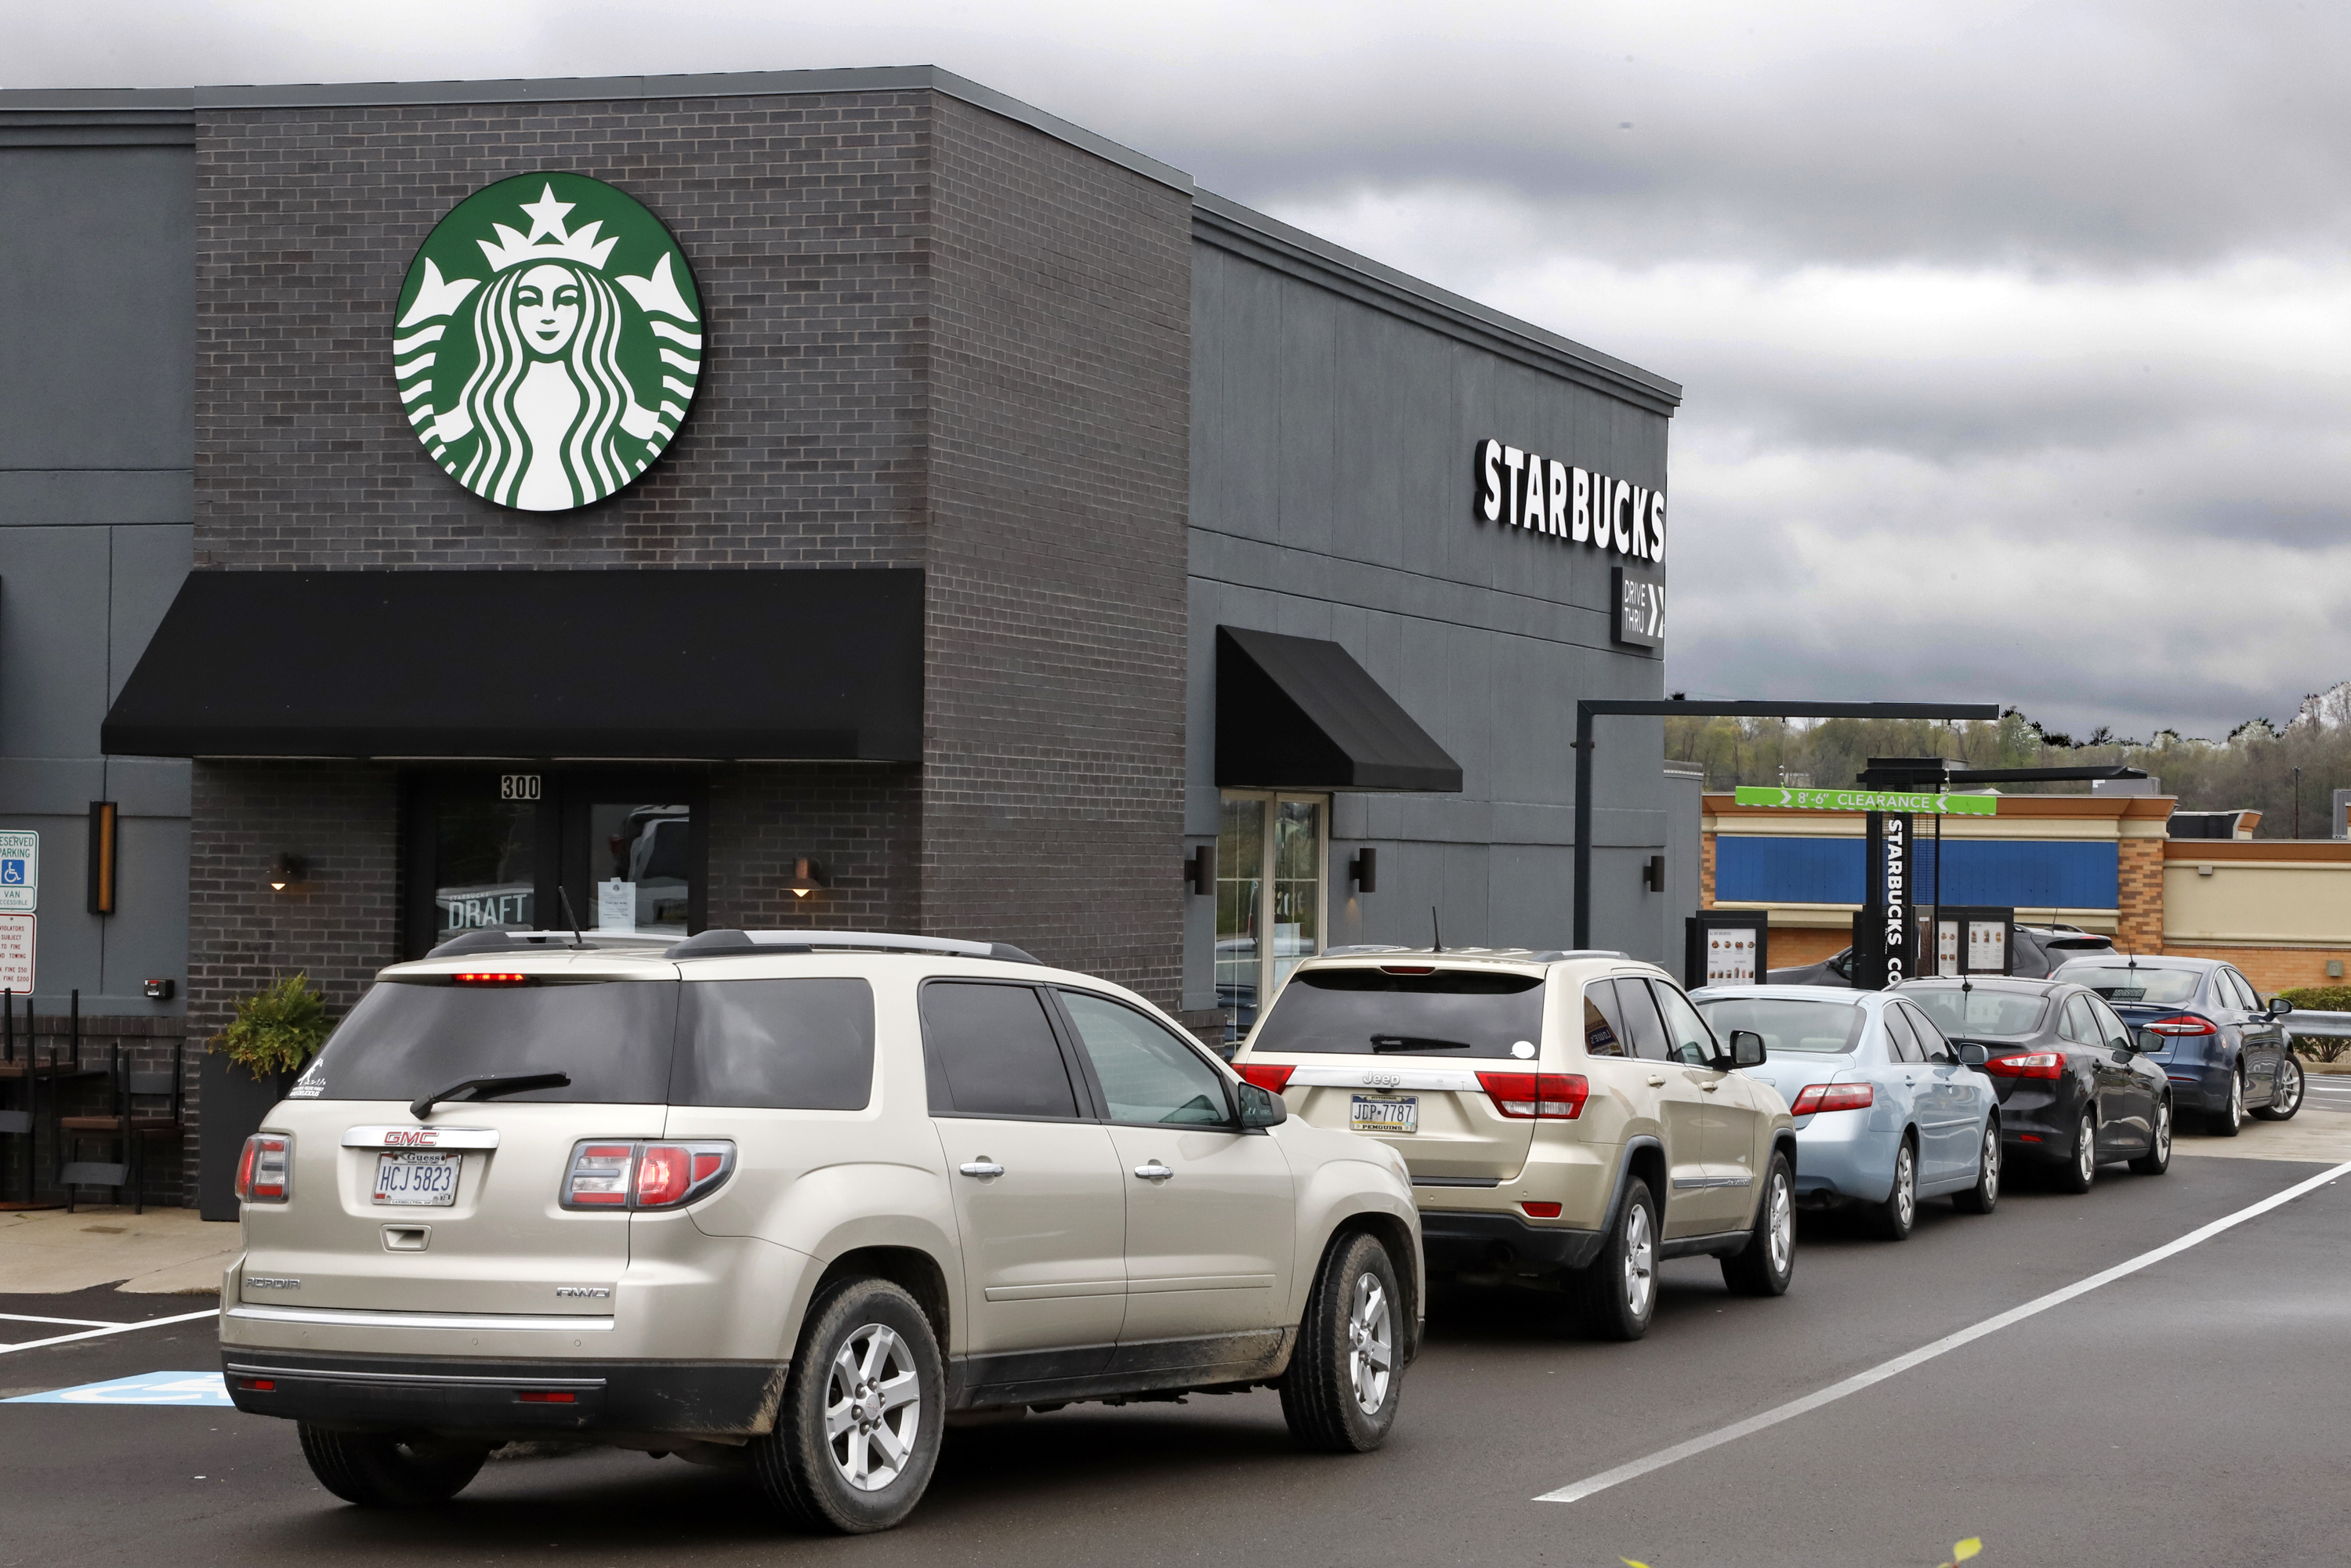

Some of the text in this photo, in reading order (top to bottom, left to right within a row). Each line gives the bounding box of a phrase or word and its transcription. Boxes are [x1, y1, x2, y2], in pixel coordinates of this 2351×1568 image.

[1483, 438, 1665, 563] STARBUCKS
[1625, 579, 1646, 607] DRIVE
[1625, 607, 1644, 634] THRU
[502, 776, 539, 798] 300
[1837, 793, 1930, 809] CLEARANCE
[0, 836, 34, 846] ESERVED
[1888, 819, 1903, 946] STARBUCKS
[449, 892, 489, 901] STARBUCKS
[448, 893, 527, 930] DRAFT
[1362, 1070, 1400, 1088] Jeep
[383, 1131, 439, 1146] GMC
[407, 1152, 440, 1161] Guess
[379, 1165, 452, 1192] HCJ 5823
[245, 1276, 301, 1289] ACADIA
[556, 1286, 610, 1298] AWD
